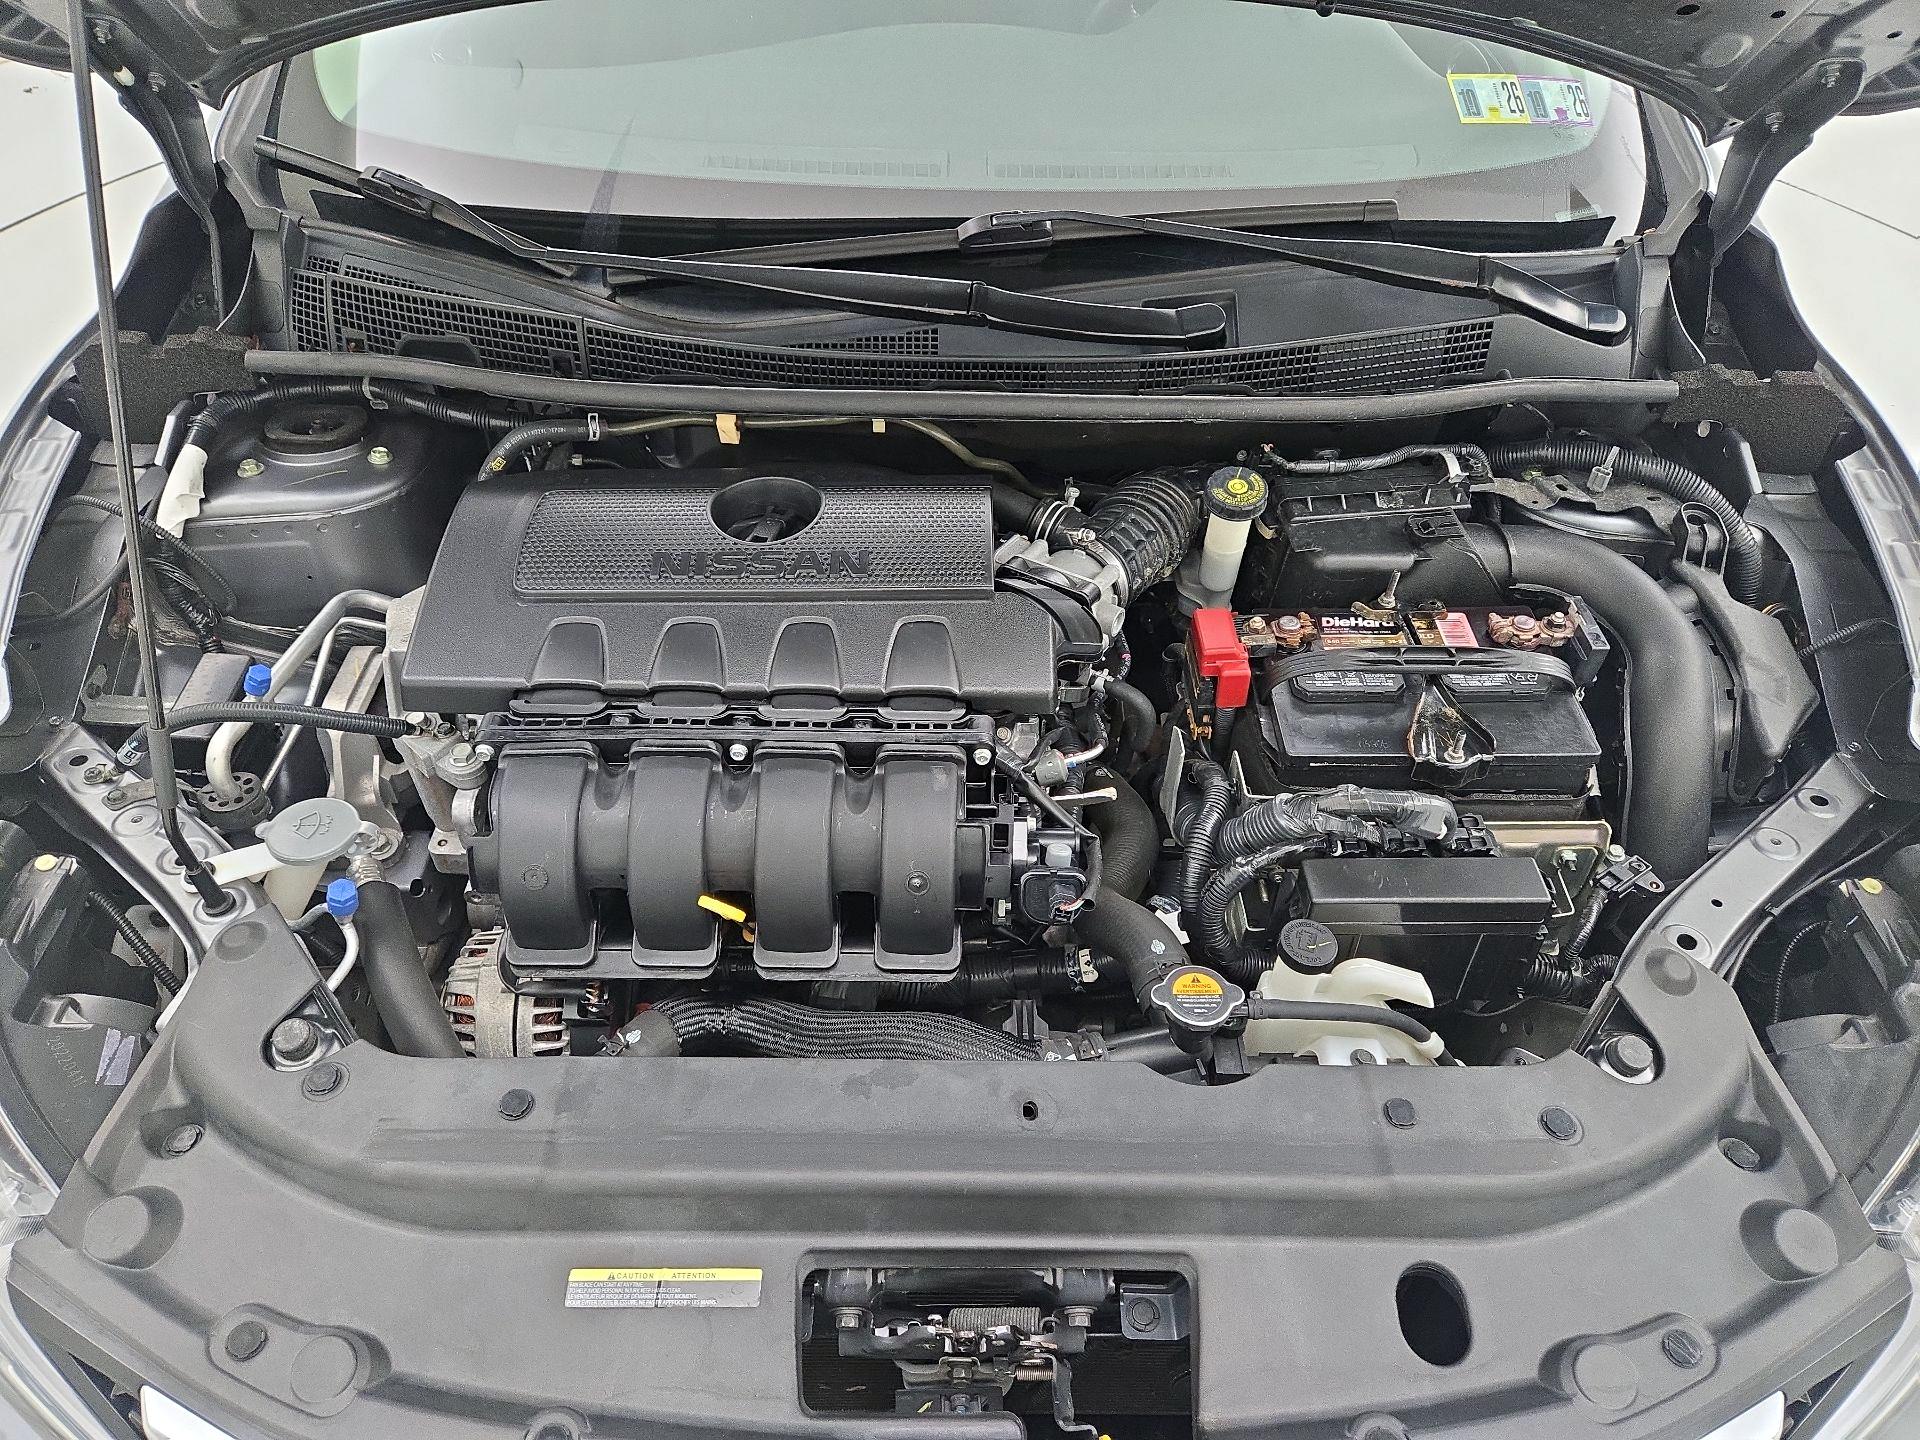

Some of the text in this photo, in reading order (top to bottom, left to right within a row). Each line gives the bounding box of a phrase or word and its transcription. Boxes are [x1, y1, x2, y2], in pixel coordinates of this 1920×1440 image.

[1458, 88, 1481, 117] 10
[1501, 81, 1525, 114] 26
[1567, 84, 1589, 118] 26
[650, 549, 871, 579] NISSAN
[616, 1272, 655, 1280] CAUTION
